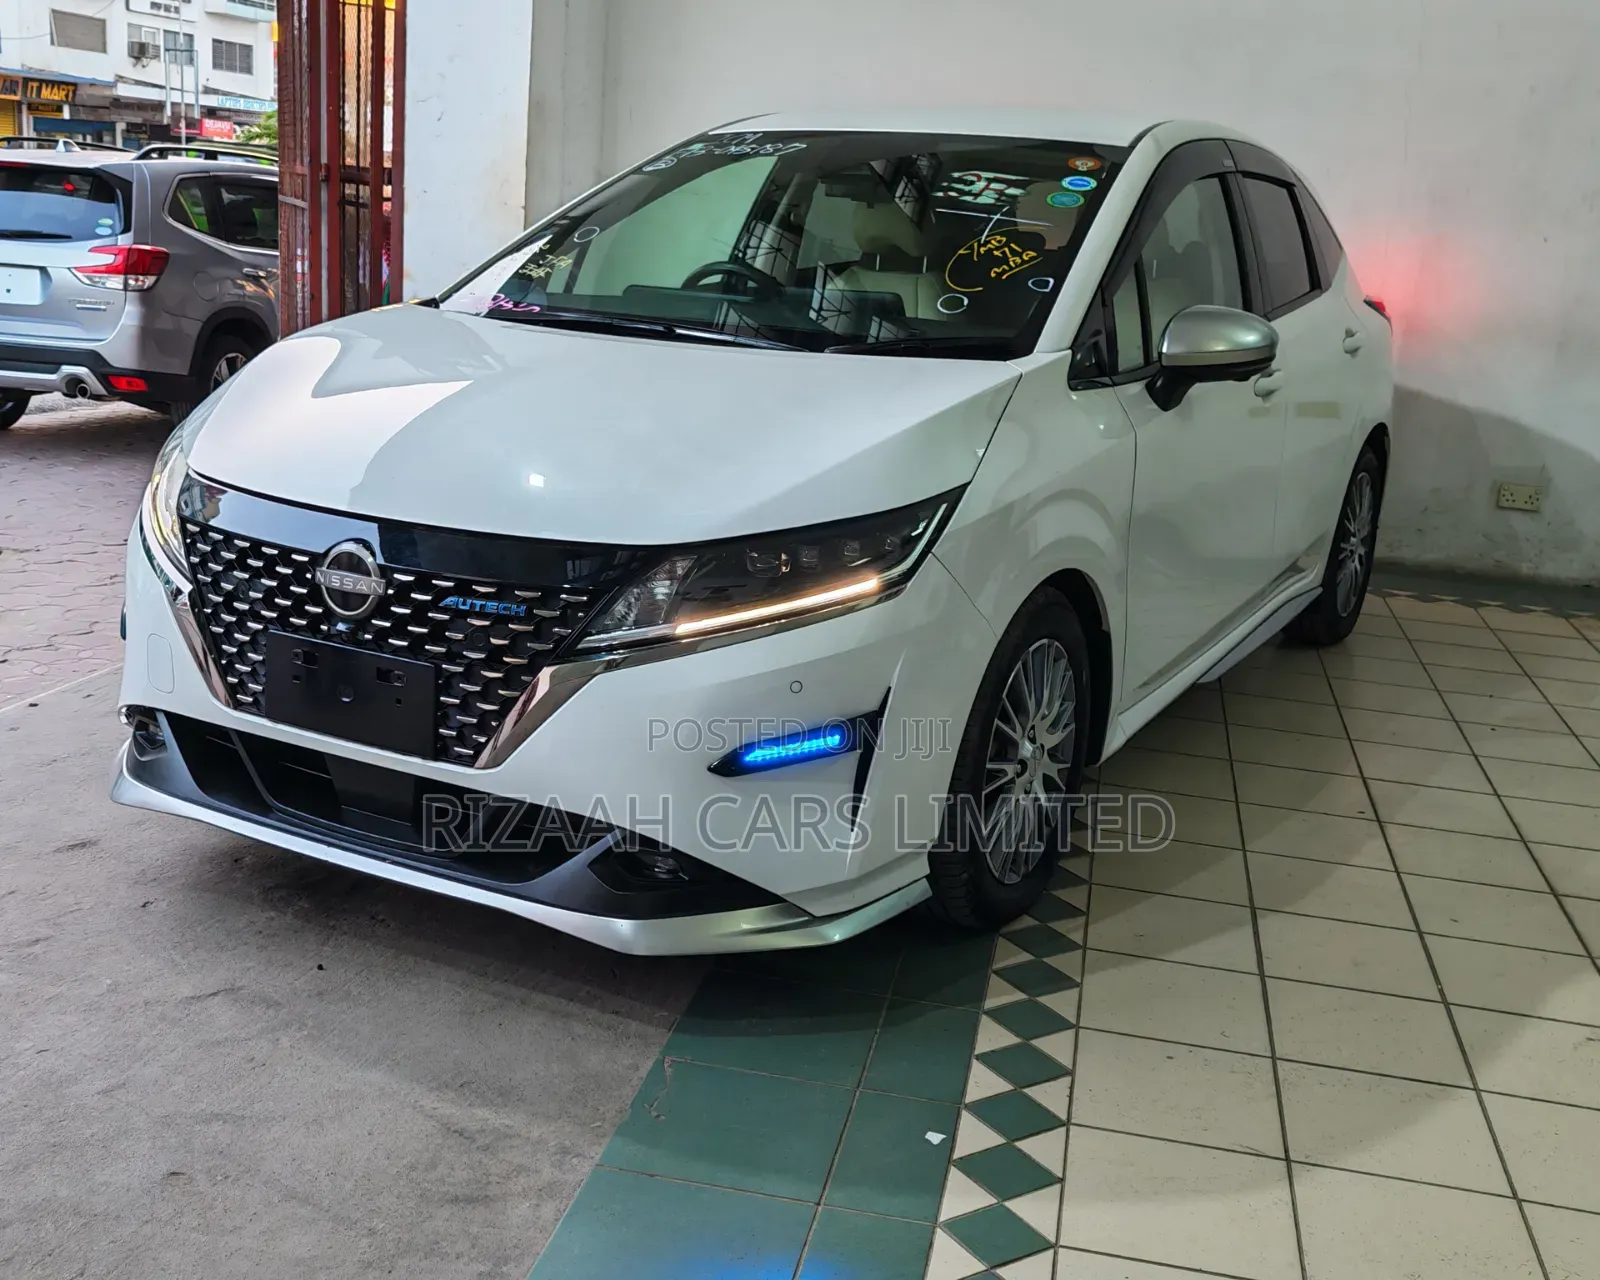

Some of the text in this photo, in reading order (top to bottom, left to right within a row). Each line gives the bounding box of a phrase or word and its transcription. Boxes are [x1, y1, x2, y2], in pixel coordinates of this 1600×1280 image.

[27, 81, 75, 101] IT MART
[315, 571, 385, 594] NISSAN
[438, 596, 527, 617] AUTECH
